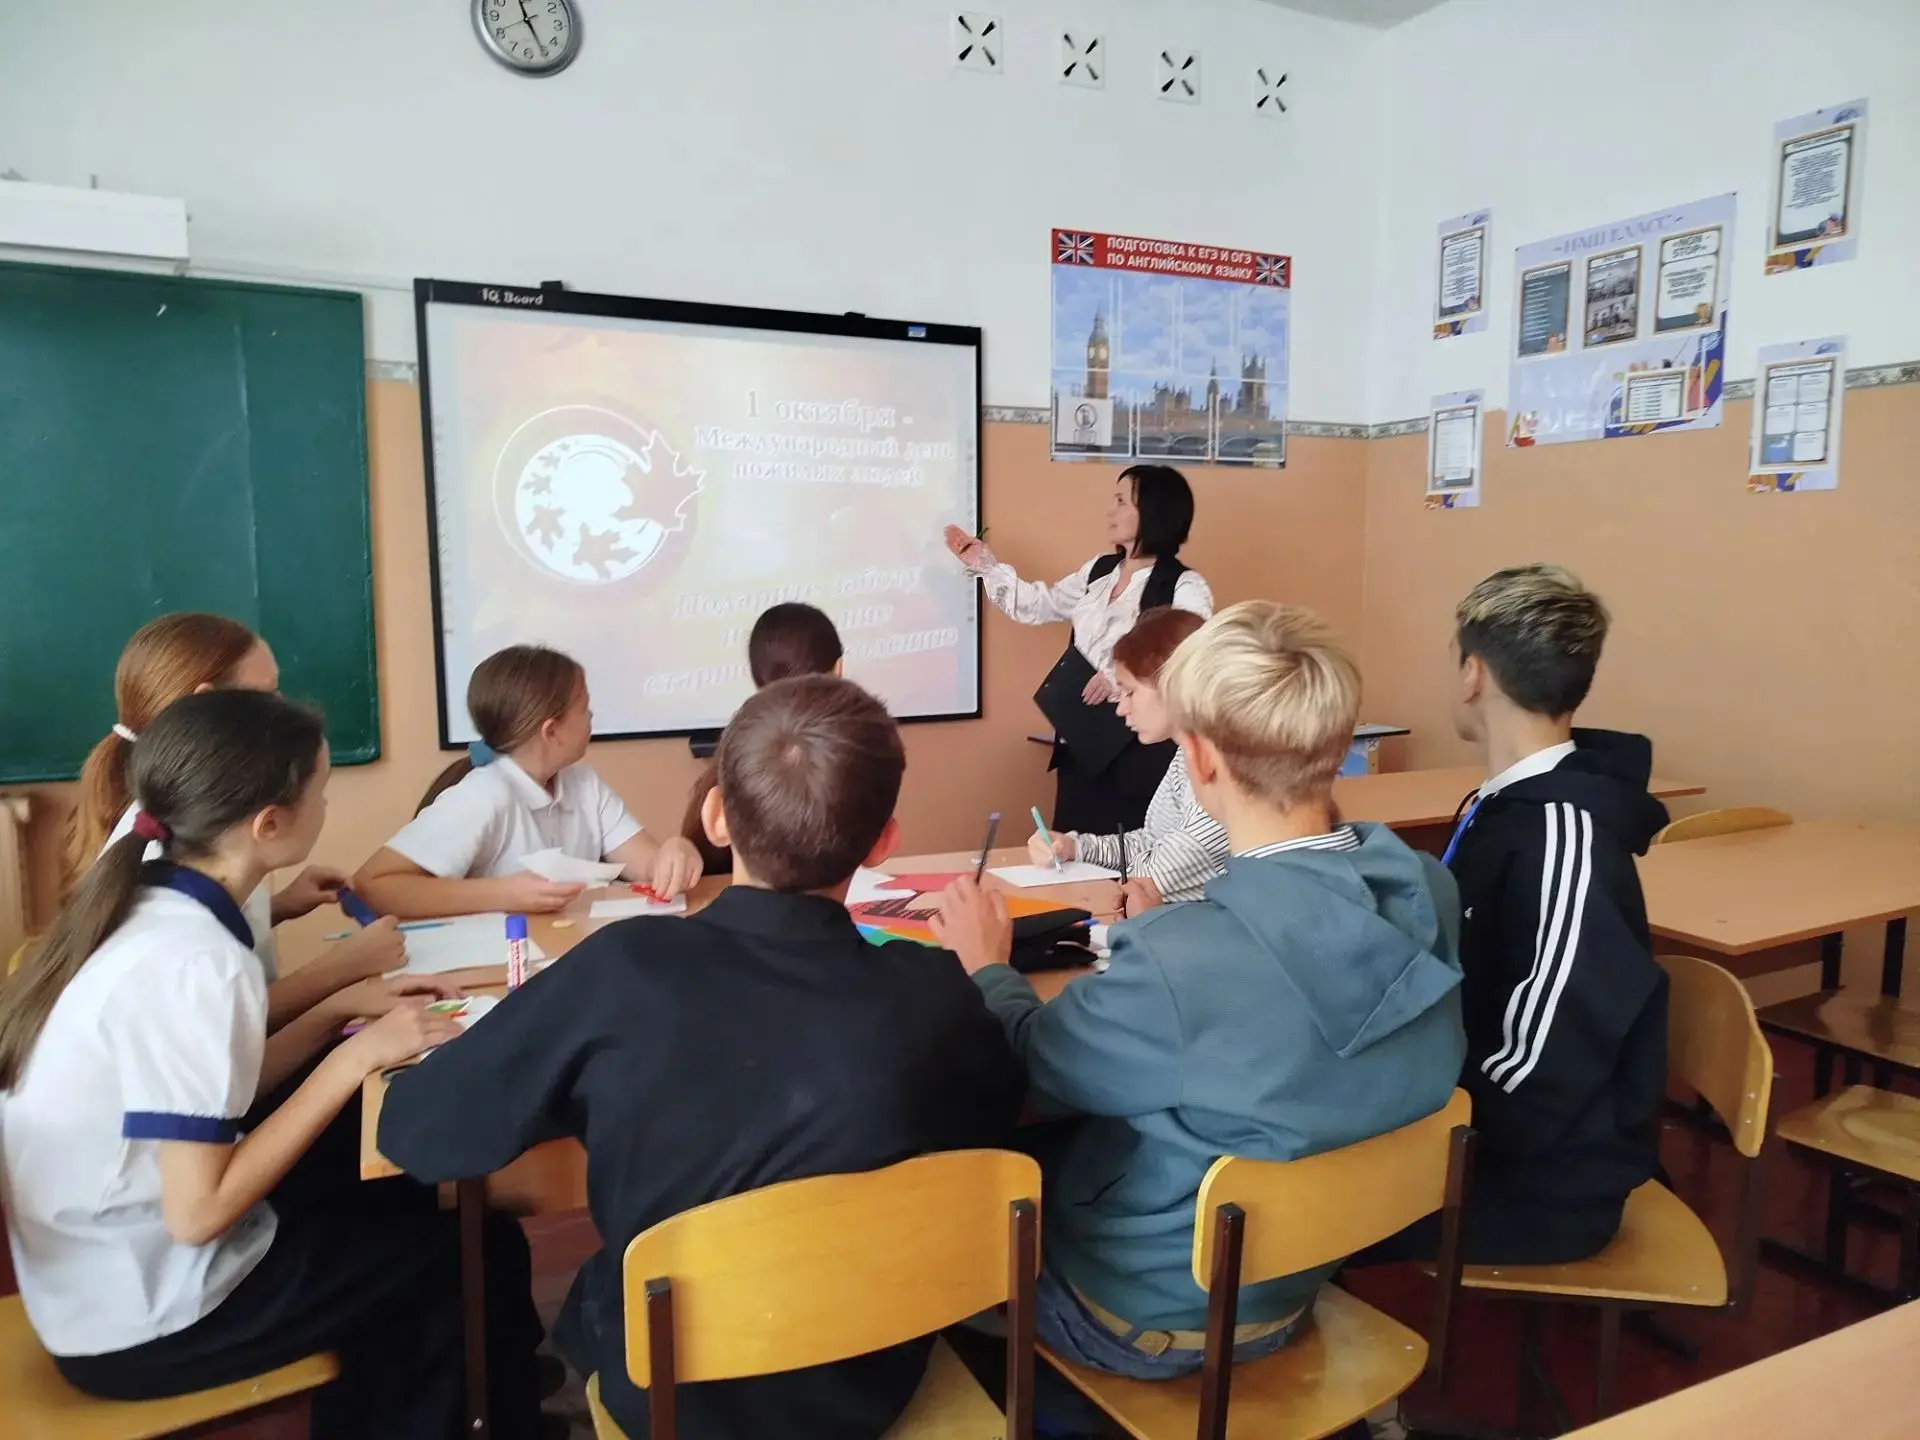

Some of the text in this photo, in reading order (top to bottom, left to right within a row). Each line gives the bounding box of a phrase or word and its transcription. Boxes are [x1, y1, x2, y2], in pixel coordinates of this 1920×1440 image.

[547, 2, 557, 14] 2
[489, 10, 500, 21] 9
[553, 19, 563, 31] 3
[496, 28, 506, 39] 8
[509, 41, 519, 52] 7
[549, 36, 559, 47] 4
[523, 48, 534, 60] 6
[1106, 236, 1252, 264] ПОДГОТОВКА К ЕГЭ И ОГЭ
[1106, 252, 1253, 280] ПО АНГЛИЙСКОМУ ЯЗЫКУ
[503, 290, 543, 305] Board
[746, 388, 761, 420] 1
[775, 397, 896, 433] октября
